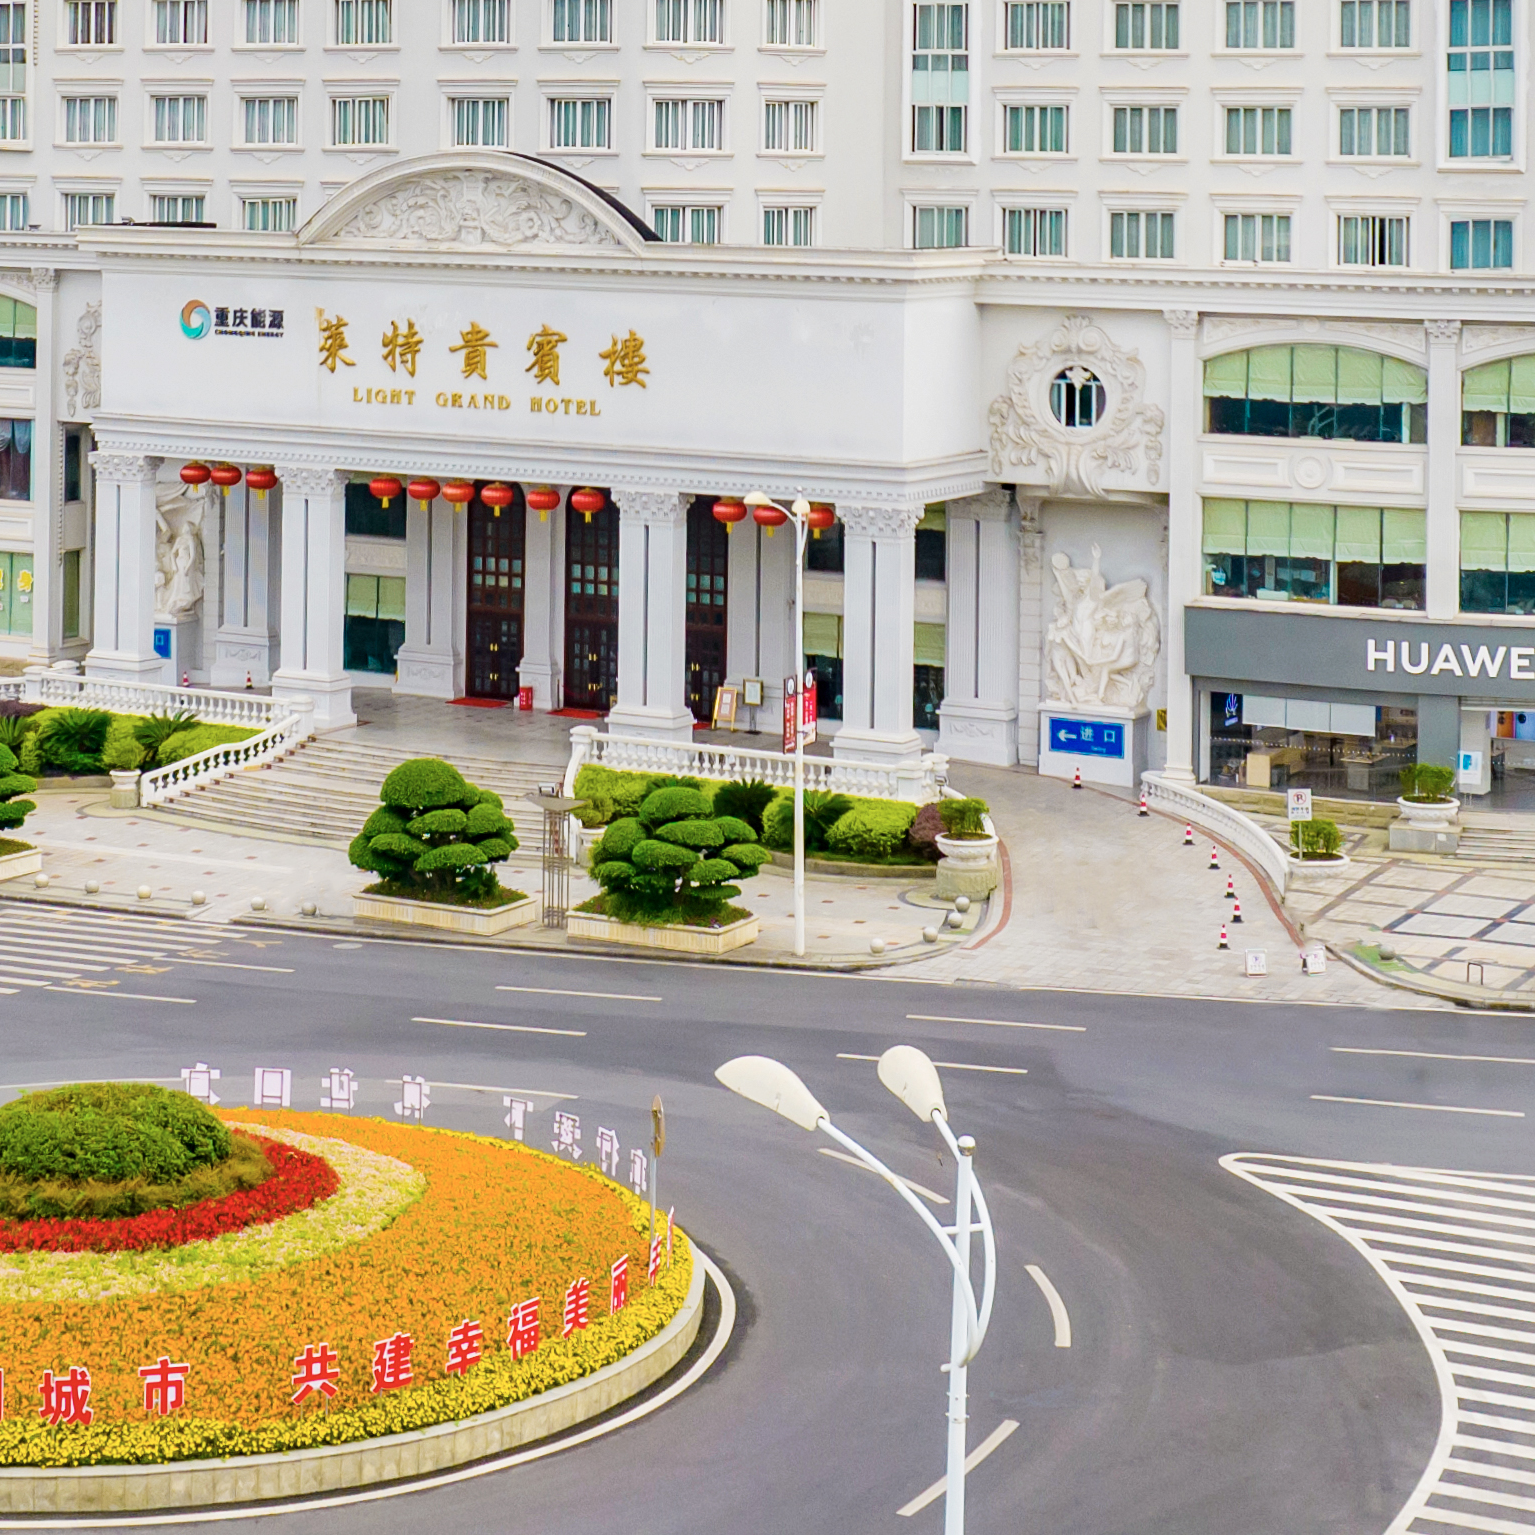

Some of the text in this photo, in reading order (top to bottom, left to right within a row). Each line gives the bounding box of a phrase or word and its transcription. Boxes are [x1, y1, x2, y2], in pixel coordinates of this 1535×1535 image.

[214, 307, 284, 329] 重庆能源
[353, 387, 602, 416] LIGHT GRAND HOTEL
[1080, 725, 1116, 743] 进口
